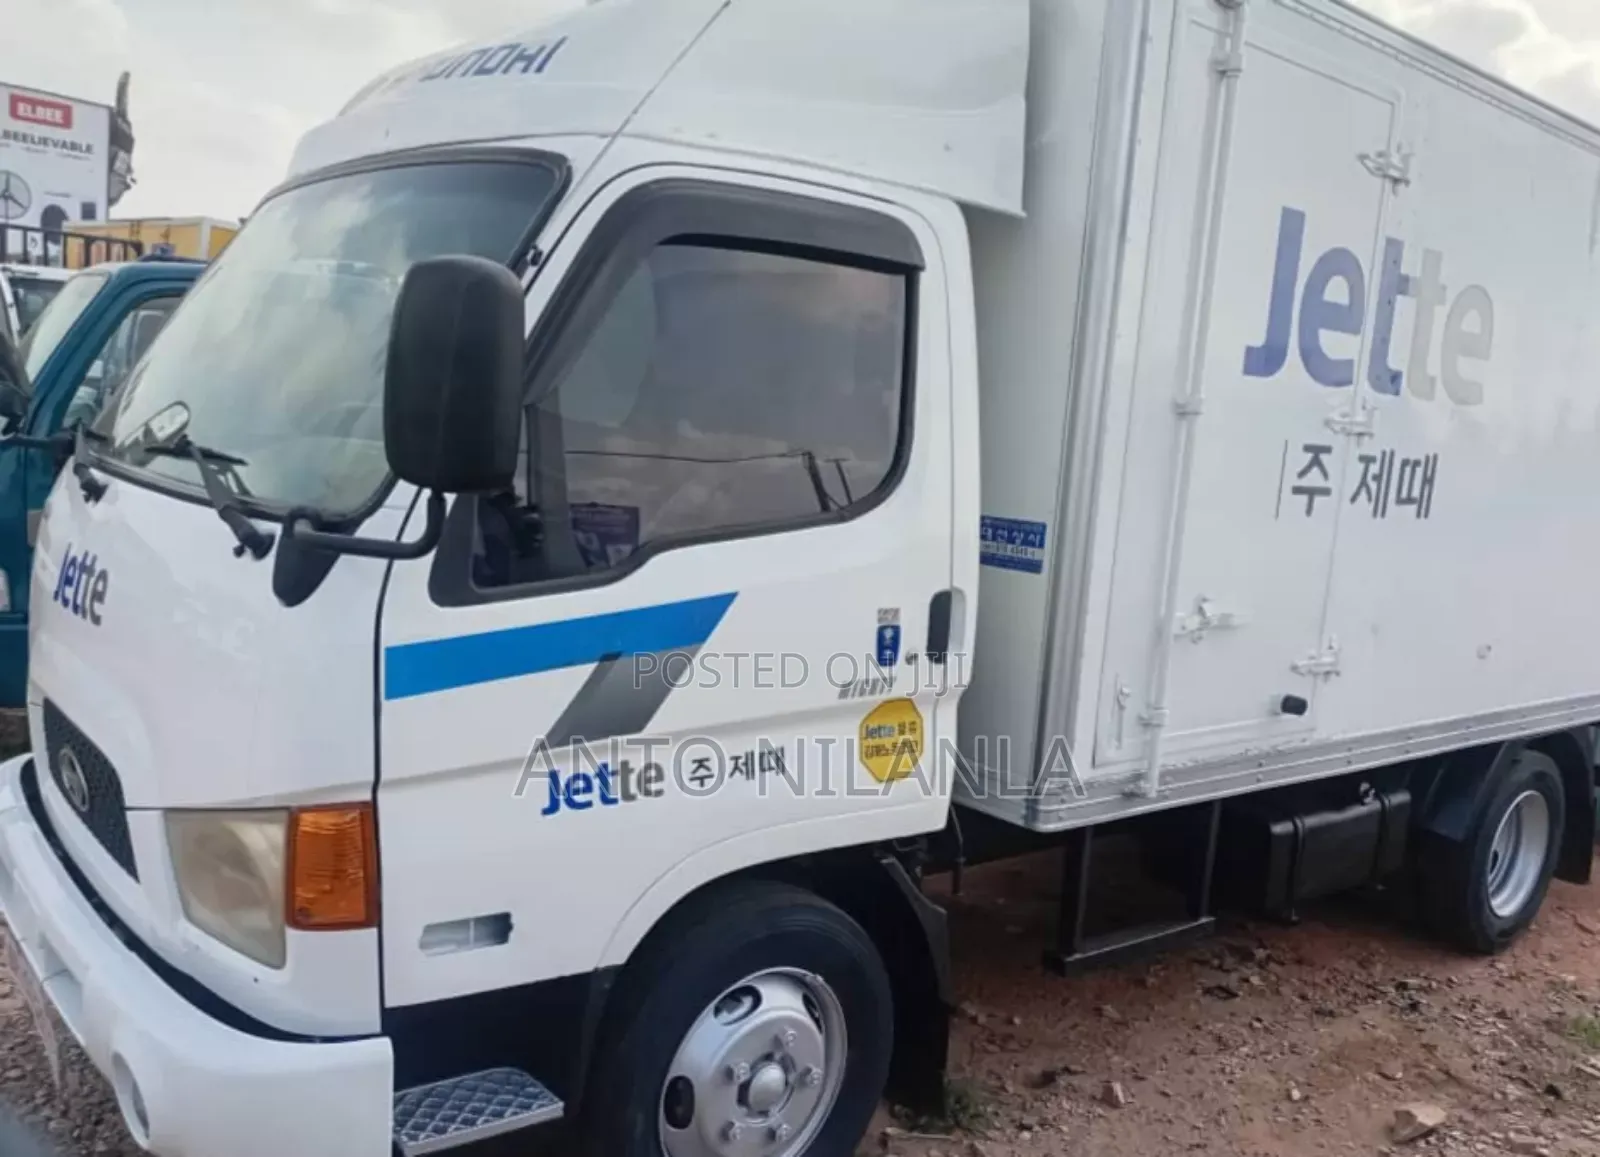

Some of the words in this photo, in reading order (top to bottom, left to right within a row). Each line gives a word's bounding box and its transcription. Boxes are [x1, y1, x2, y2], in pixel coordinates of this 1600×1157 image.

[0, 129, 94, 155] BEELIEVABLE
[1242, 206, 1494, 406] Jette
[1350, 449, 1438, 520] 제때
[53, 542, 108, 627] Jette
[540, 757, 665, 816] Jette
